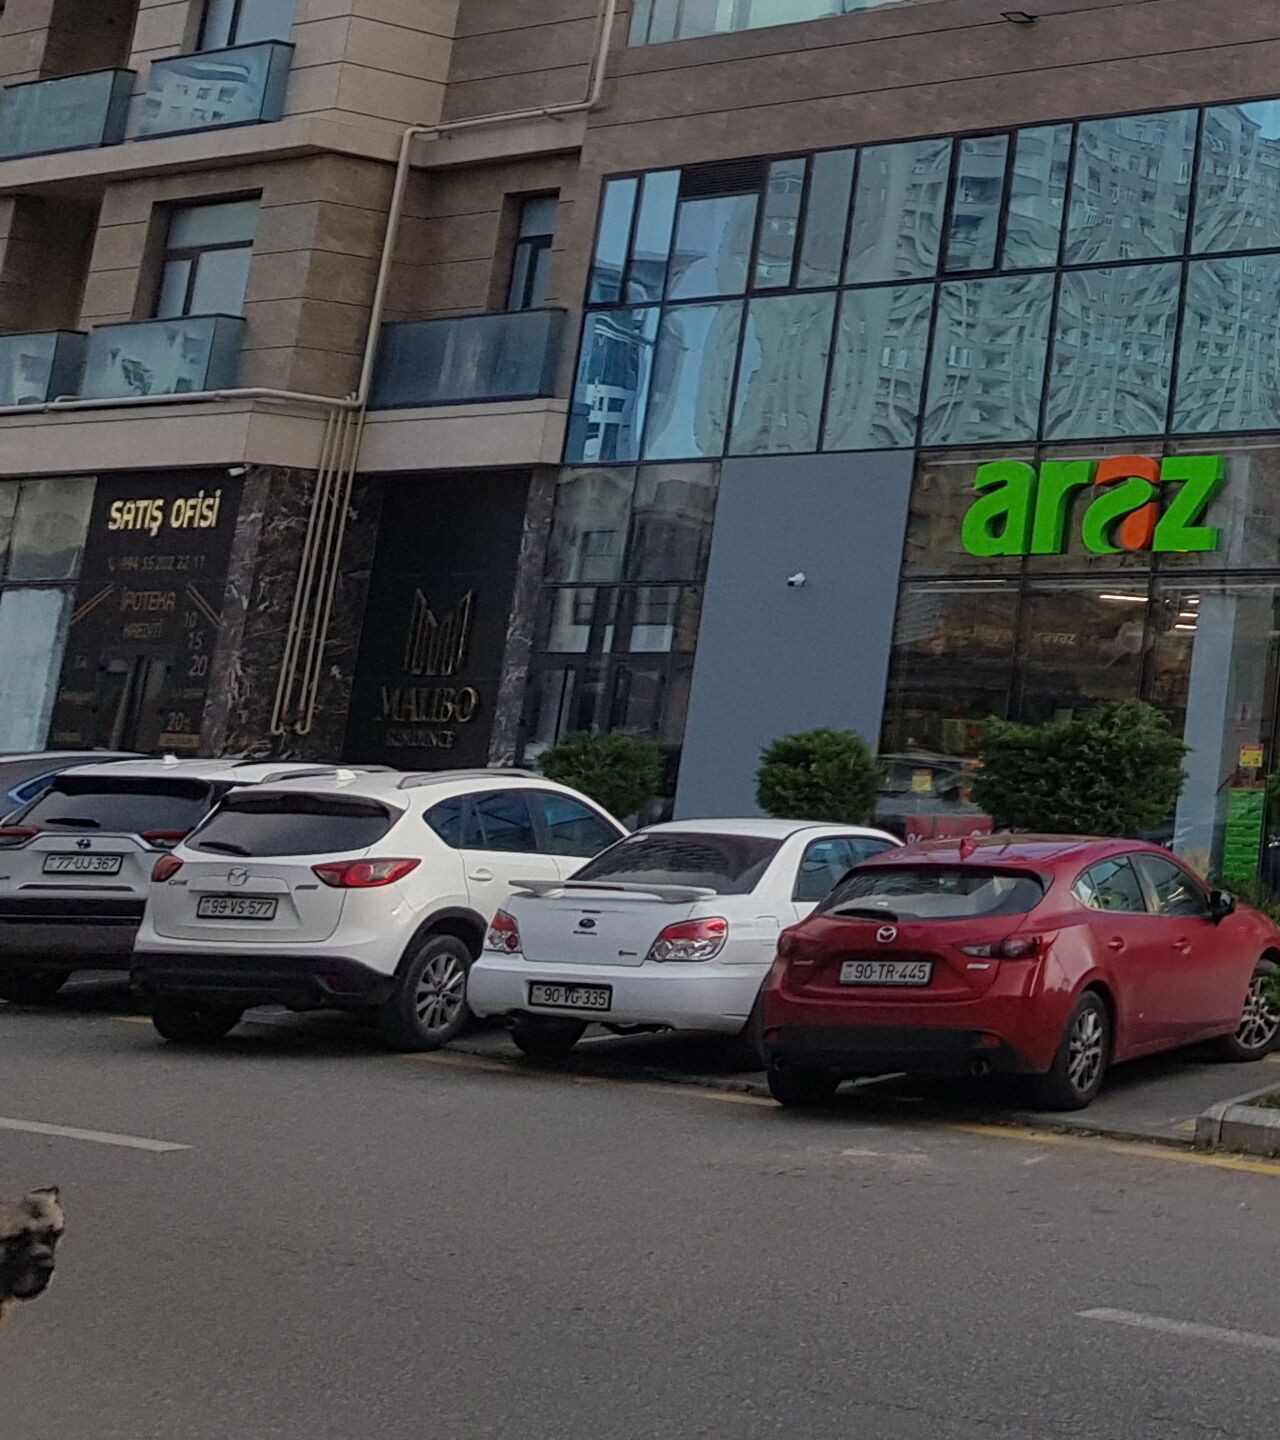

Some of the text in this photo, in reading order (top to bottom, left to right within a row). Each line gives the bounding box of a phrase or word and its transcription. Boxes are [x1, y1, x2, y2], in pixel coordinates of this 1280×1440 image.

[108, 489, 222, 537] SATIŞ OFİSİ
[961, 454, 1226, 557] araz
[210, 898, 275, 916] 99-VS-577
[854, 963, 928, 981] 90-TR-445
[543, 986, 607, 1007] 90-VG-335
